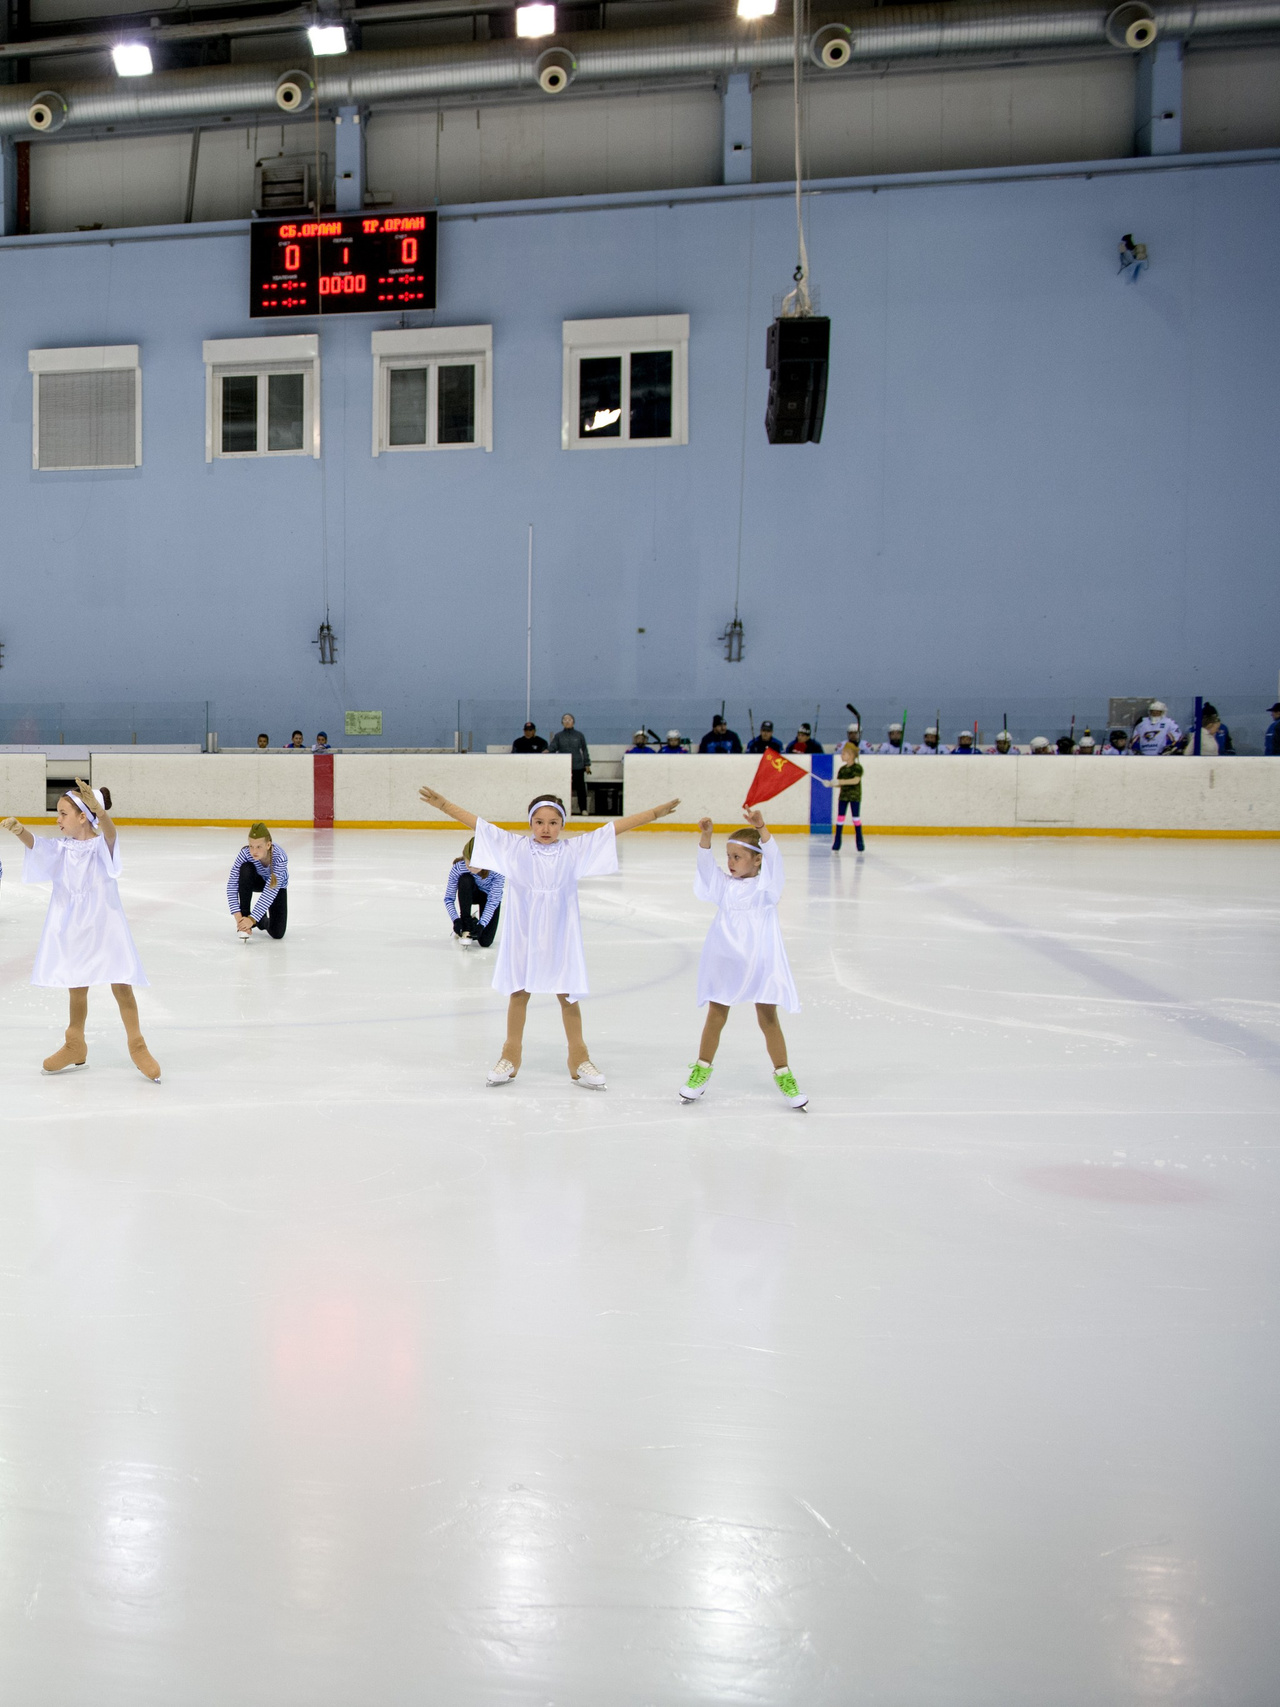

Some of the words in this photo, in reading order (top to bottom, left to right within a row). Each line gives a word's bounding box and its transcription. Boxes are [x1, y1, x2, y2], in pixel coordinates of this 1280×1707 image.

[279, 222, 342, 238] СБ.ОРЛАН
[362, 217, 425, 233] ТР.ОРЛАН
[285, 244, 300, 270] 0
[343, 247, 349, 265] 1
[401, 237, 418, 264] 0
